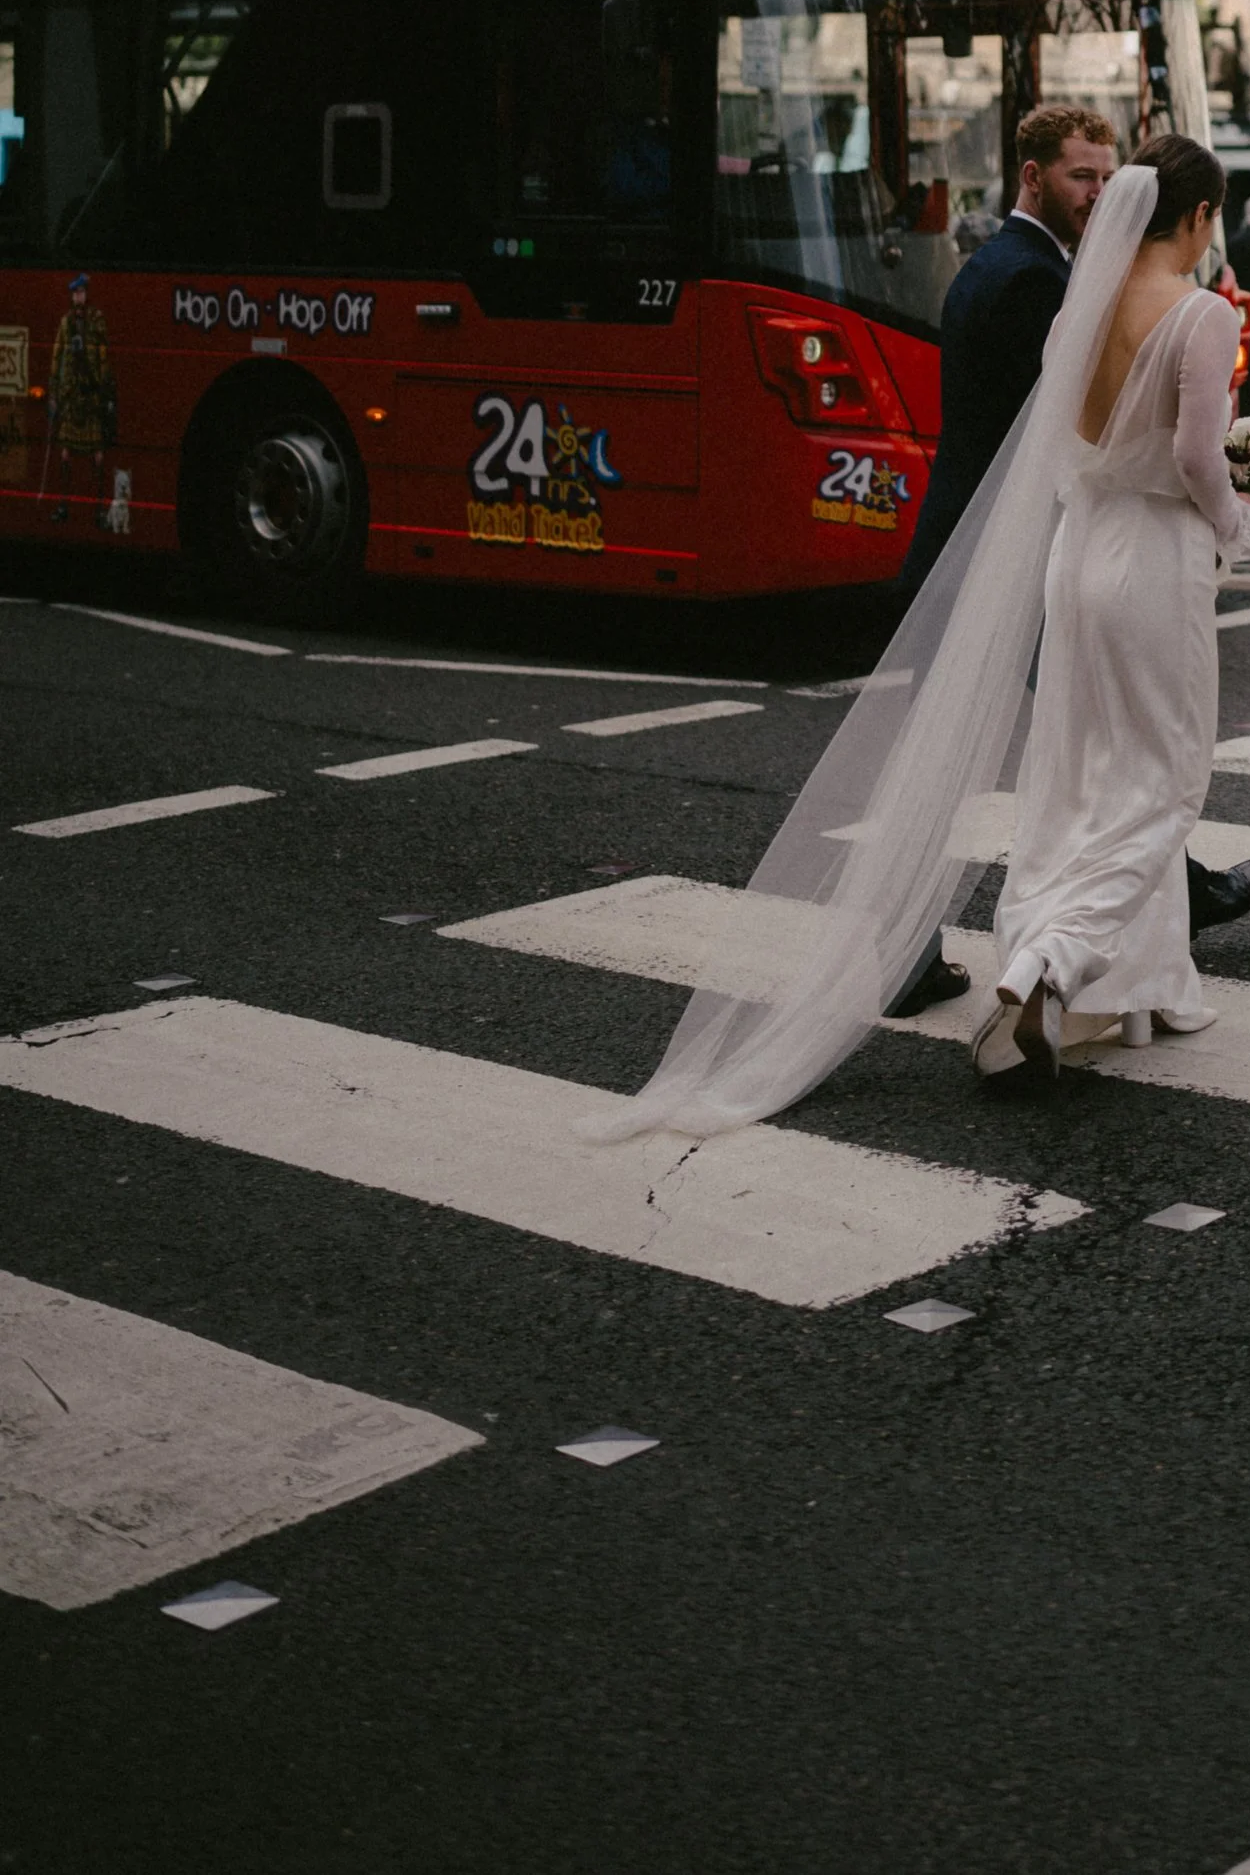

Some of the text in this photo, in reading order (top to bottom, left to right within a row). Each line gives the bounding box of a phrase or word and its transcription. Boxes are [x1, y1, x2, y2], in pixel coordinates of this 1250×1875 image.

[175, 287, 375, 336] Hop On Hop Off
[638, 278, 677, 308] 227
[473, 396, 550, 498] 24
[819, 449, 875, 503] 24
[467, 501, 606, 552] Valid Ticket
